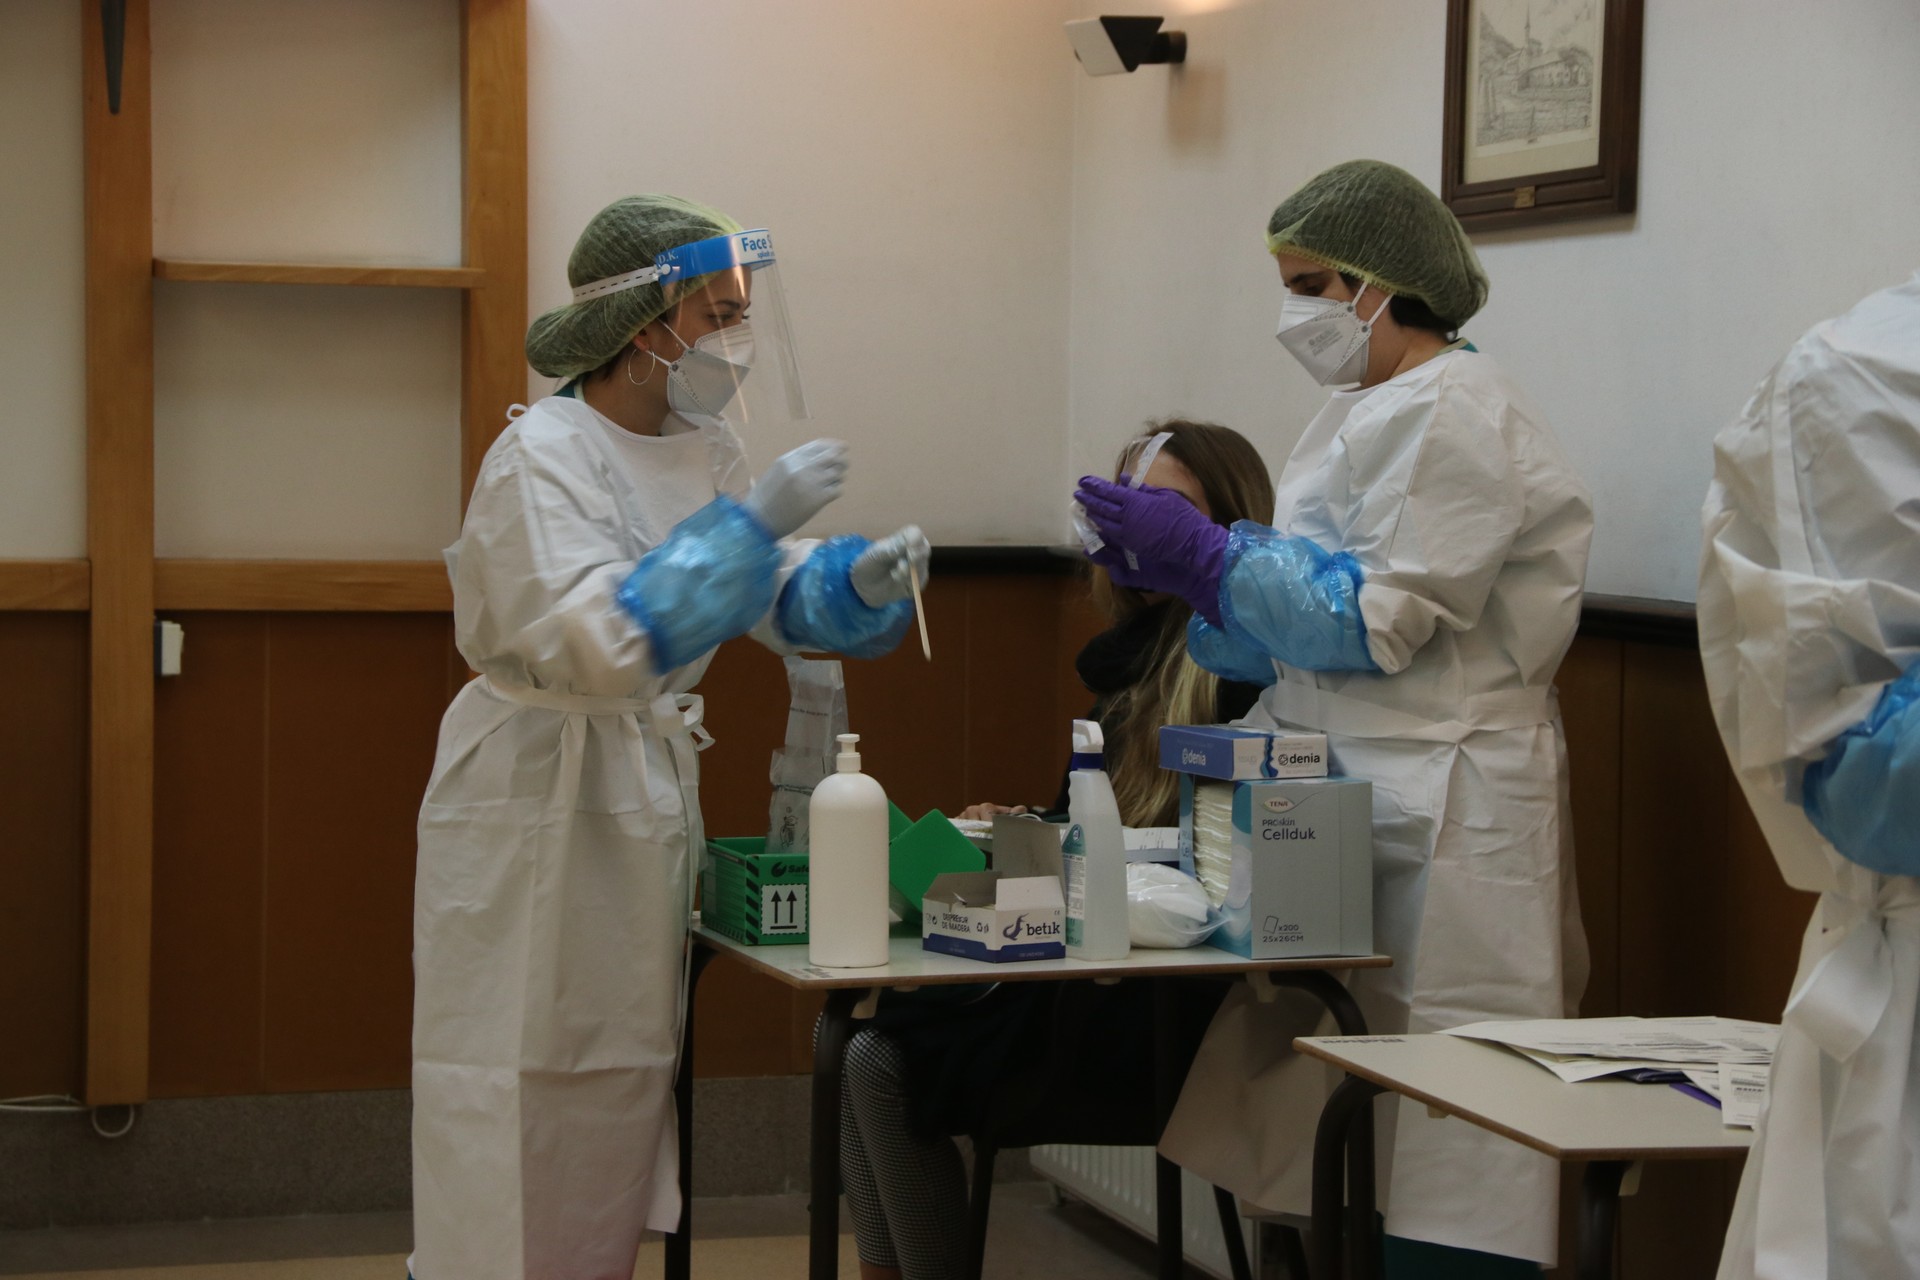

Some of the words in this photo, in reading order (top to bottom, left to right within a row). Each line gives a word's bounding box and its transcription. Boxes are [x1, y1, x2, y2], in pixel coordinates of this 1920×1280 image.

[741, 237, 767, 252] Face
[1188, 749, 1206, 766] denia
[1289, 752, 1320, 764] denia
[1262, 828, 1316, 840] Cellduk
